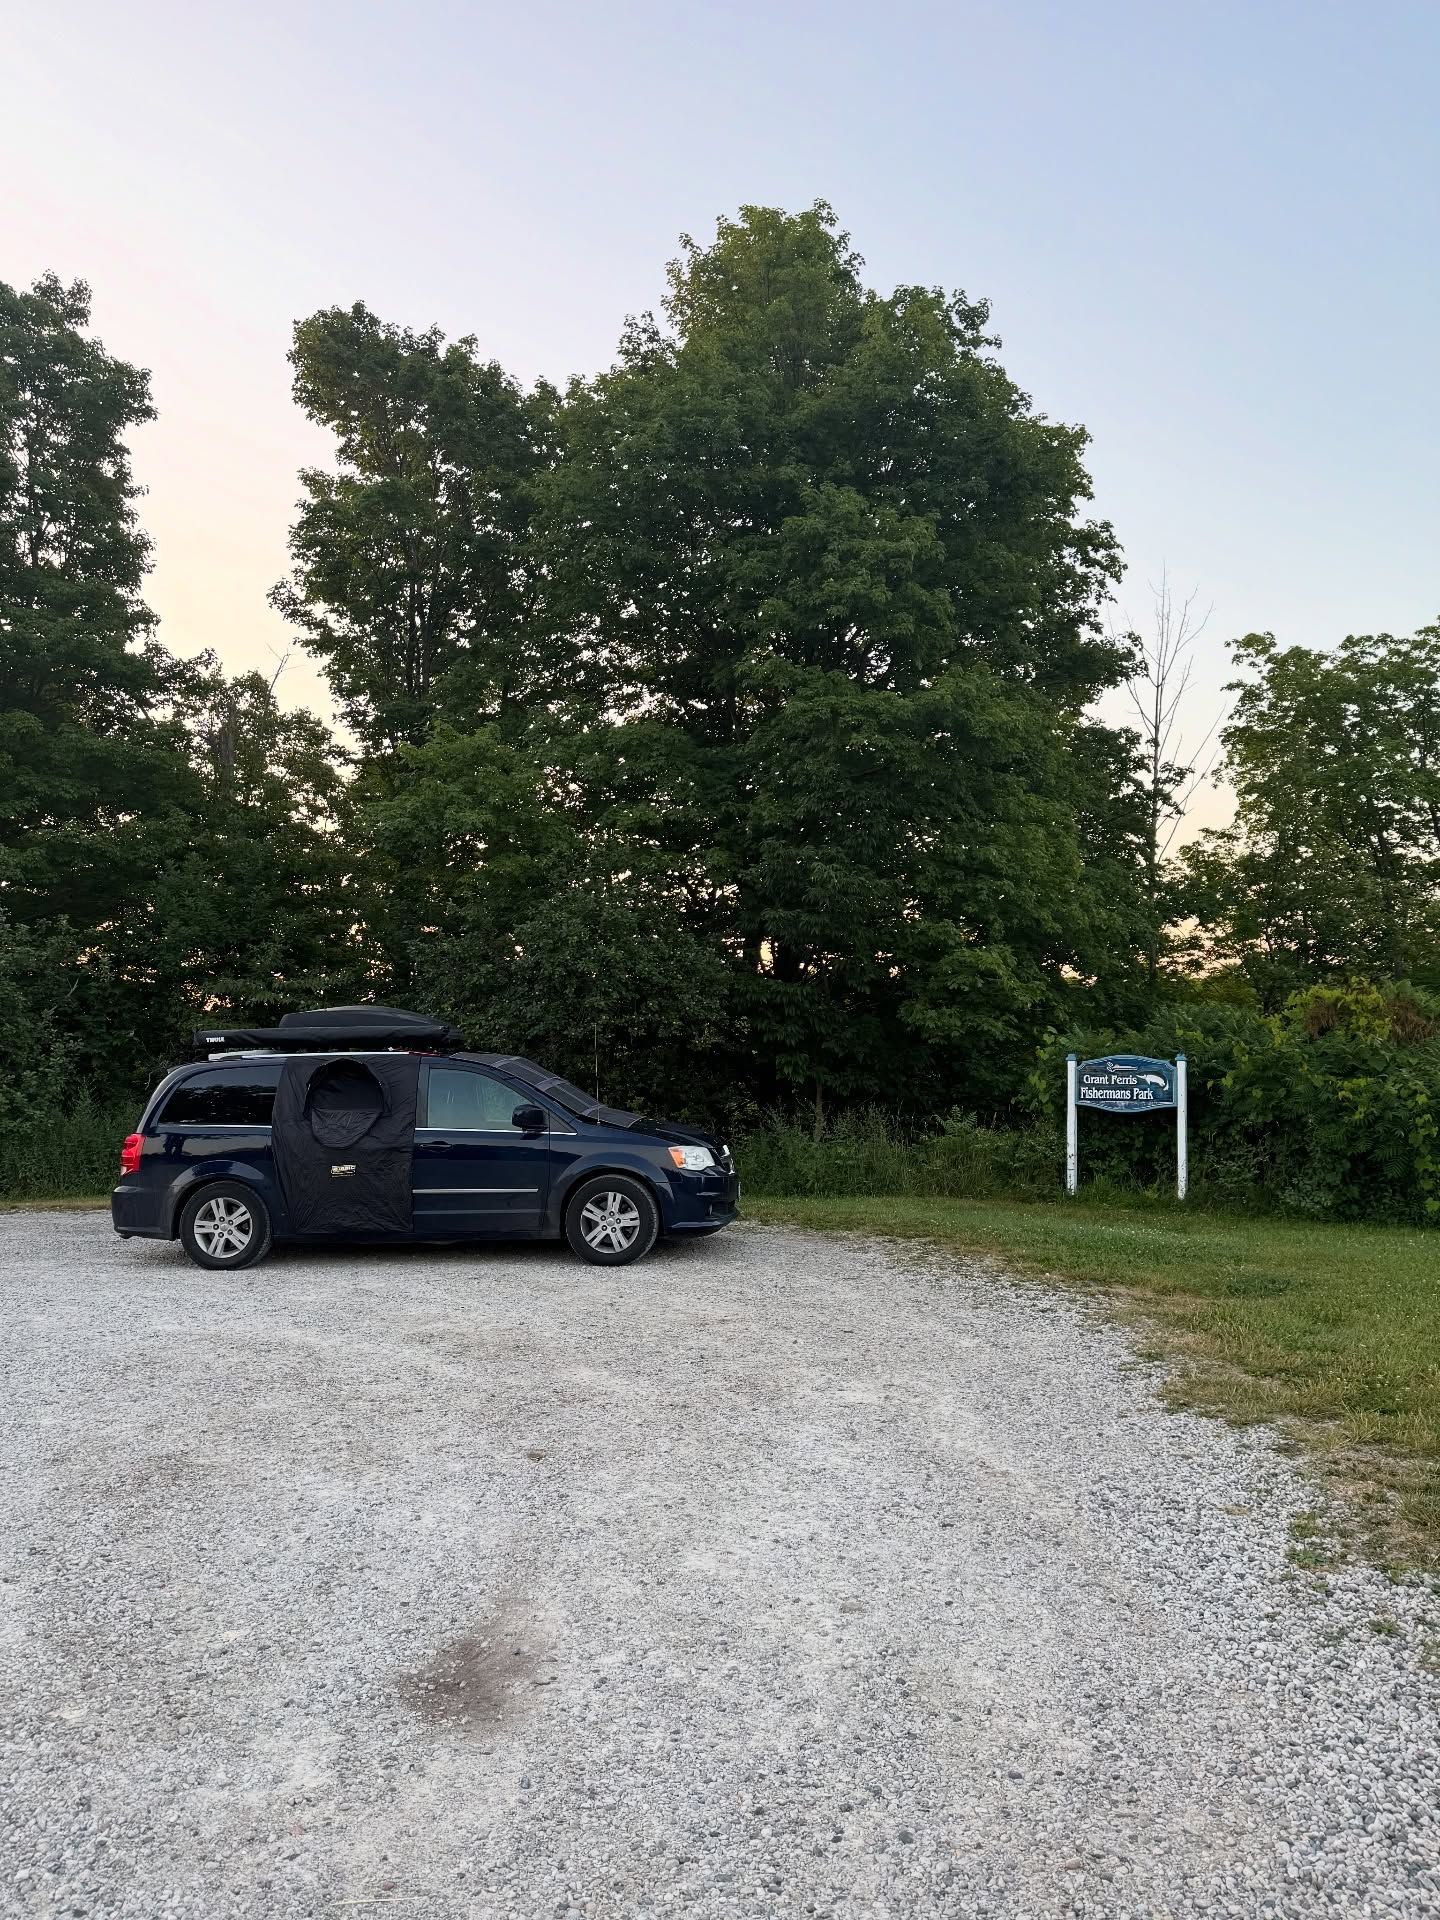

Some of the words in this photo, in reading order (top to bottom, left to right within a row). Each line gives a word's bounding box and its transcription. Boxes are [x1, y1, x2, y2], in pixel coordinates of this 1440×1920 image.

[1083, 1074, 1109, 1084] Grant
[1111, 1074, 1138, 1085] Ferris
[1080, 1087, 1131, 1099] Fishermans
[1133, 1087, 1154, 1100] Park
